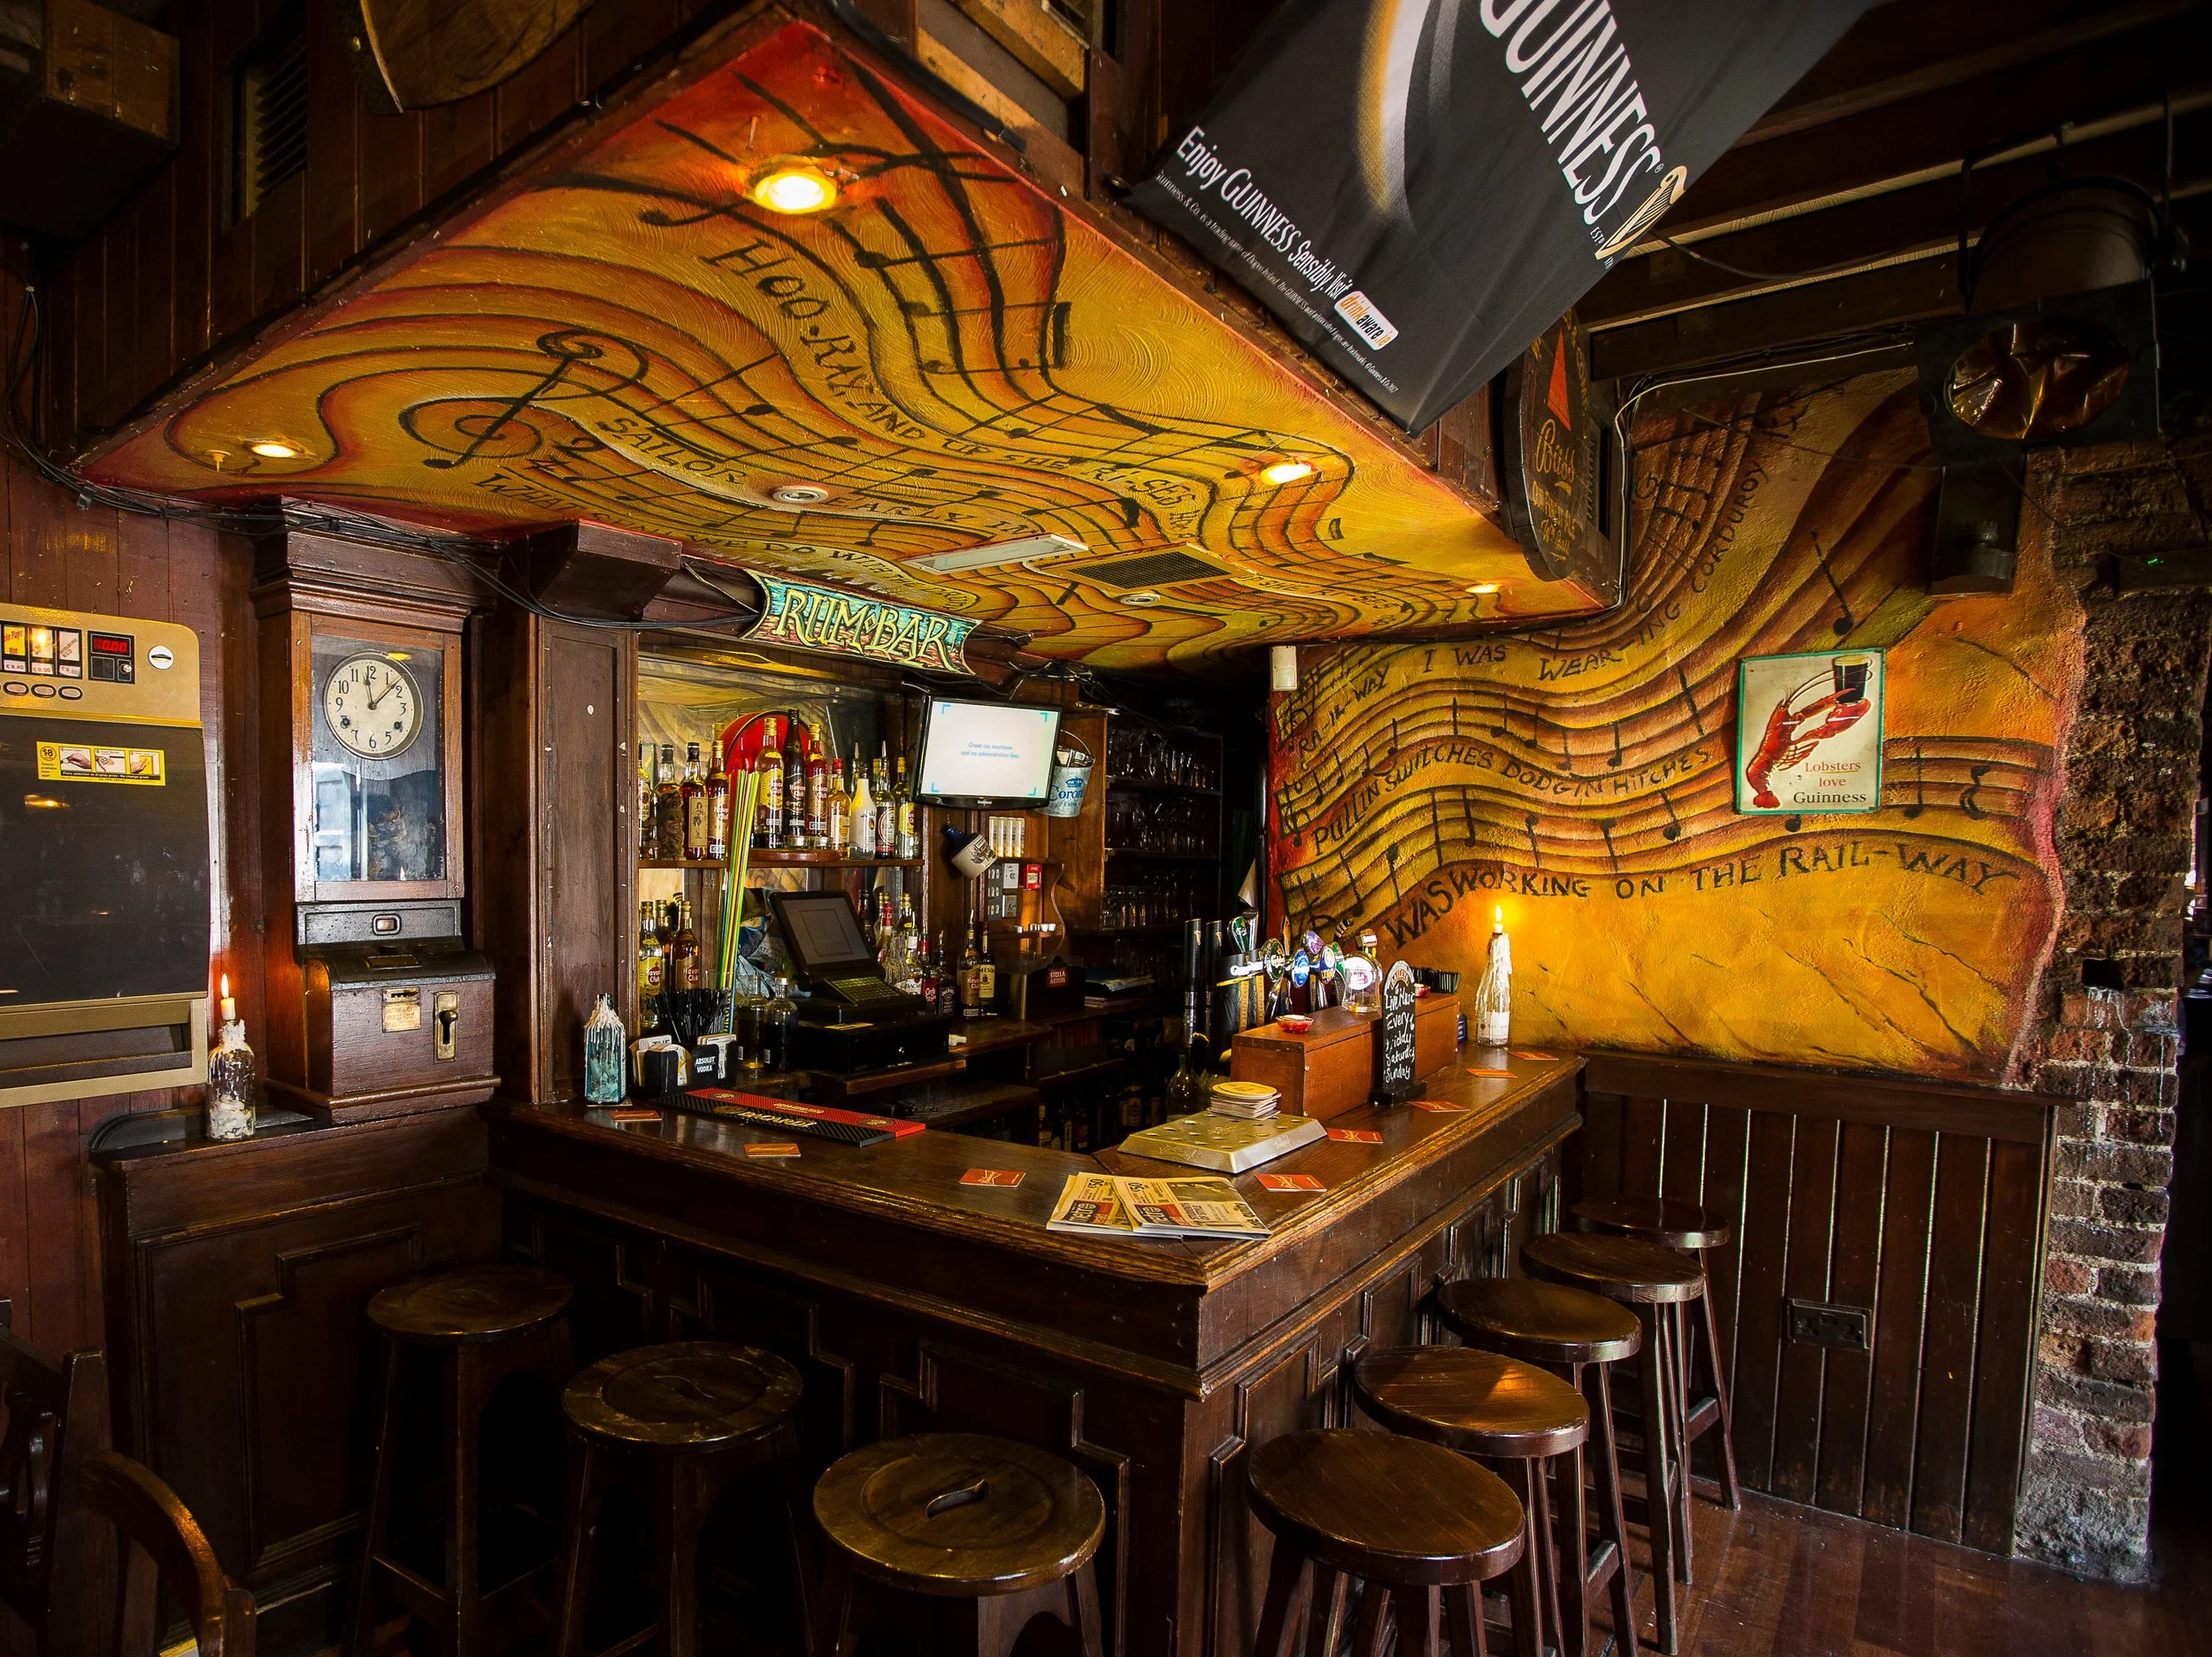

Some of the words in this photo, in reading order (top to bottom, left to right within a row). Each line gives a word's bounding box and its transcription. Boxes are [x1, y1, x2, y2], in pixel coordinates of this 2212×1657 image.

[1176, 126, 1227, 190] Enjoy
[1221, 168, 1302, 253] GUINNESS
[1287, 240, 1335, 292] Sensibly.
[1324, 272, 1354, 300] Visit
[1340, 295, 1393, 346] drinkaware.ie
[596, 417, 748, 486] SAILOR
[941, 438, 992, 456] UP
[995, 454, 1070, 471] SHE
[470, 472, 588, 511] WHAT
[824, 495, 974, 524] EARLY
[765, 541, 816, 556] DO
[829, 550, 895, 573] WITH
[1422, 648, 1437, 674] I
[1453, 645, 1509, 666] WAS
[1689, 459, 1770, 595] CORDUROY
[772, 587, 870, 657] RUM
[864, 607, 964, 676] BAR
[350, 668, 359, 683] 11
[366, 665, 376, 680] 12
[386, 672, 389, 686] 1
[338, 680, 349, 694] 10
[396, 686, 403, 699] 2
[335, 697, 343, 713] 9
[400, 702, 407, 717] 3
[350, 730, 359, 744] 7
[369, 733, 377, 749] 6
[385, 732, 392, 746] 5
[1611, 748, 1711, 794] HITCHES
[1805, 760, 1861, 772] Lobsters
[1819, 778, 1846, 787] love
[1793, 792, 1867, 804] Guinness
[1383, 881, 1455, 952] WAS
[1448, 865, 1593, 899] WORKING
[1615, 878, 1666, 901] ON
[1689, 854, 1763, 892] THE
[696, 1064, 713, 1073] VODKA
